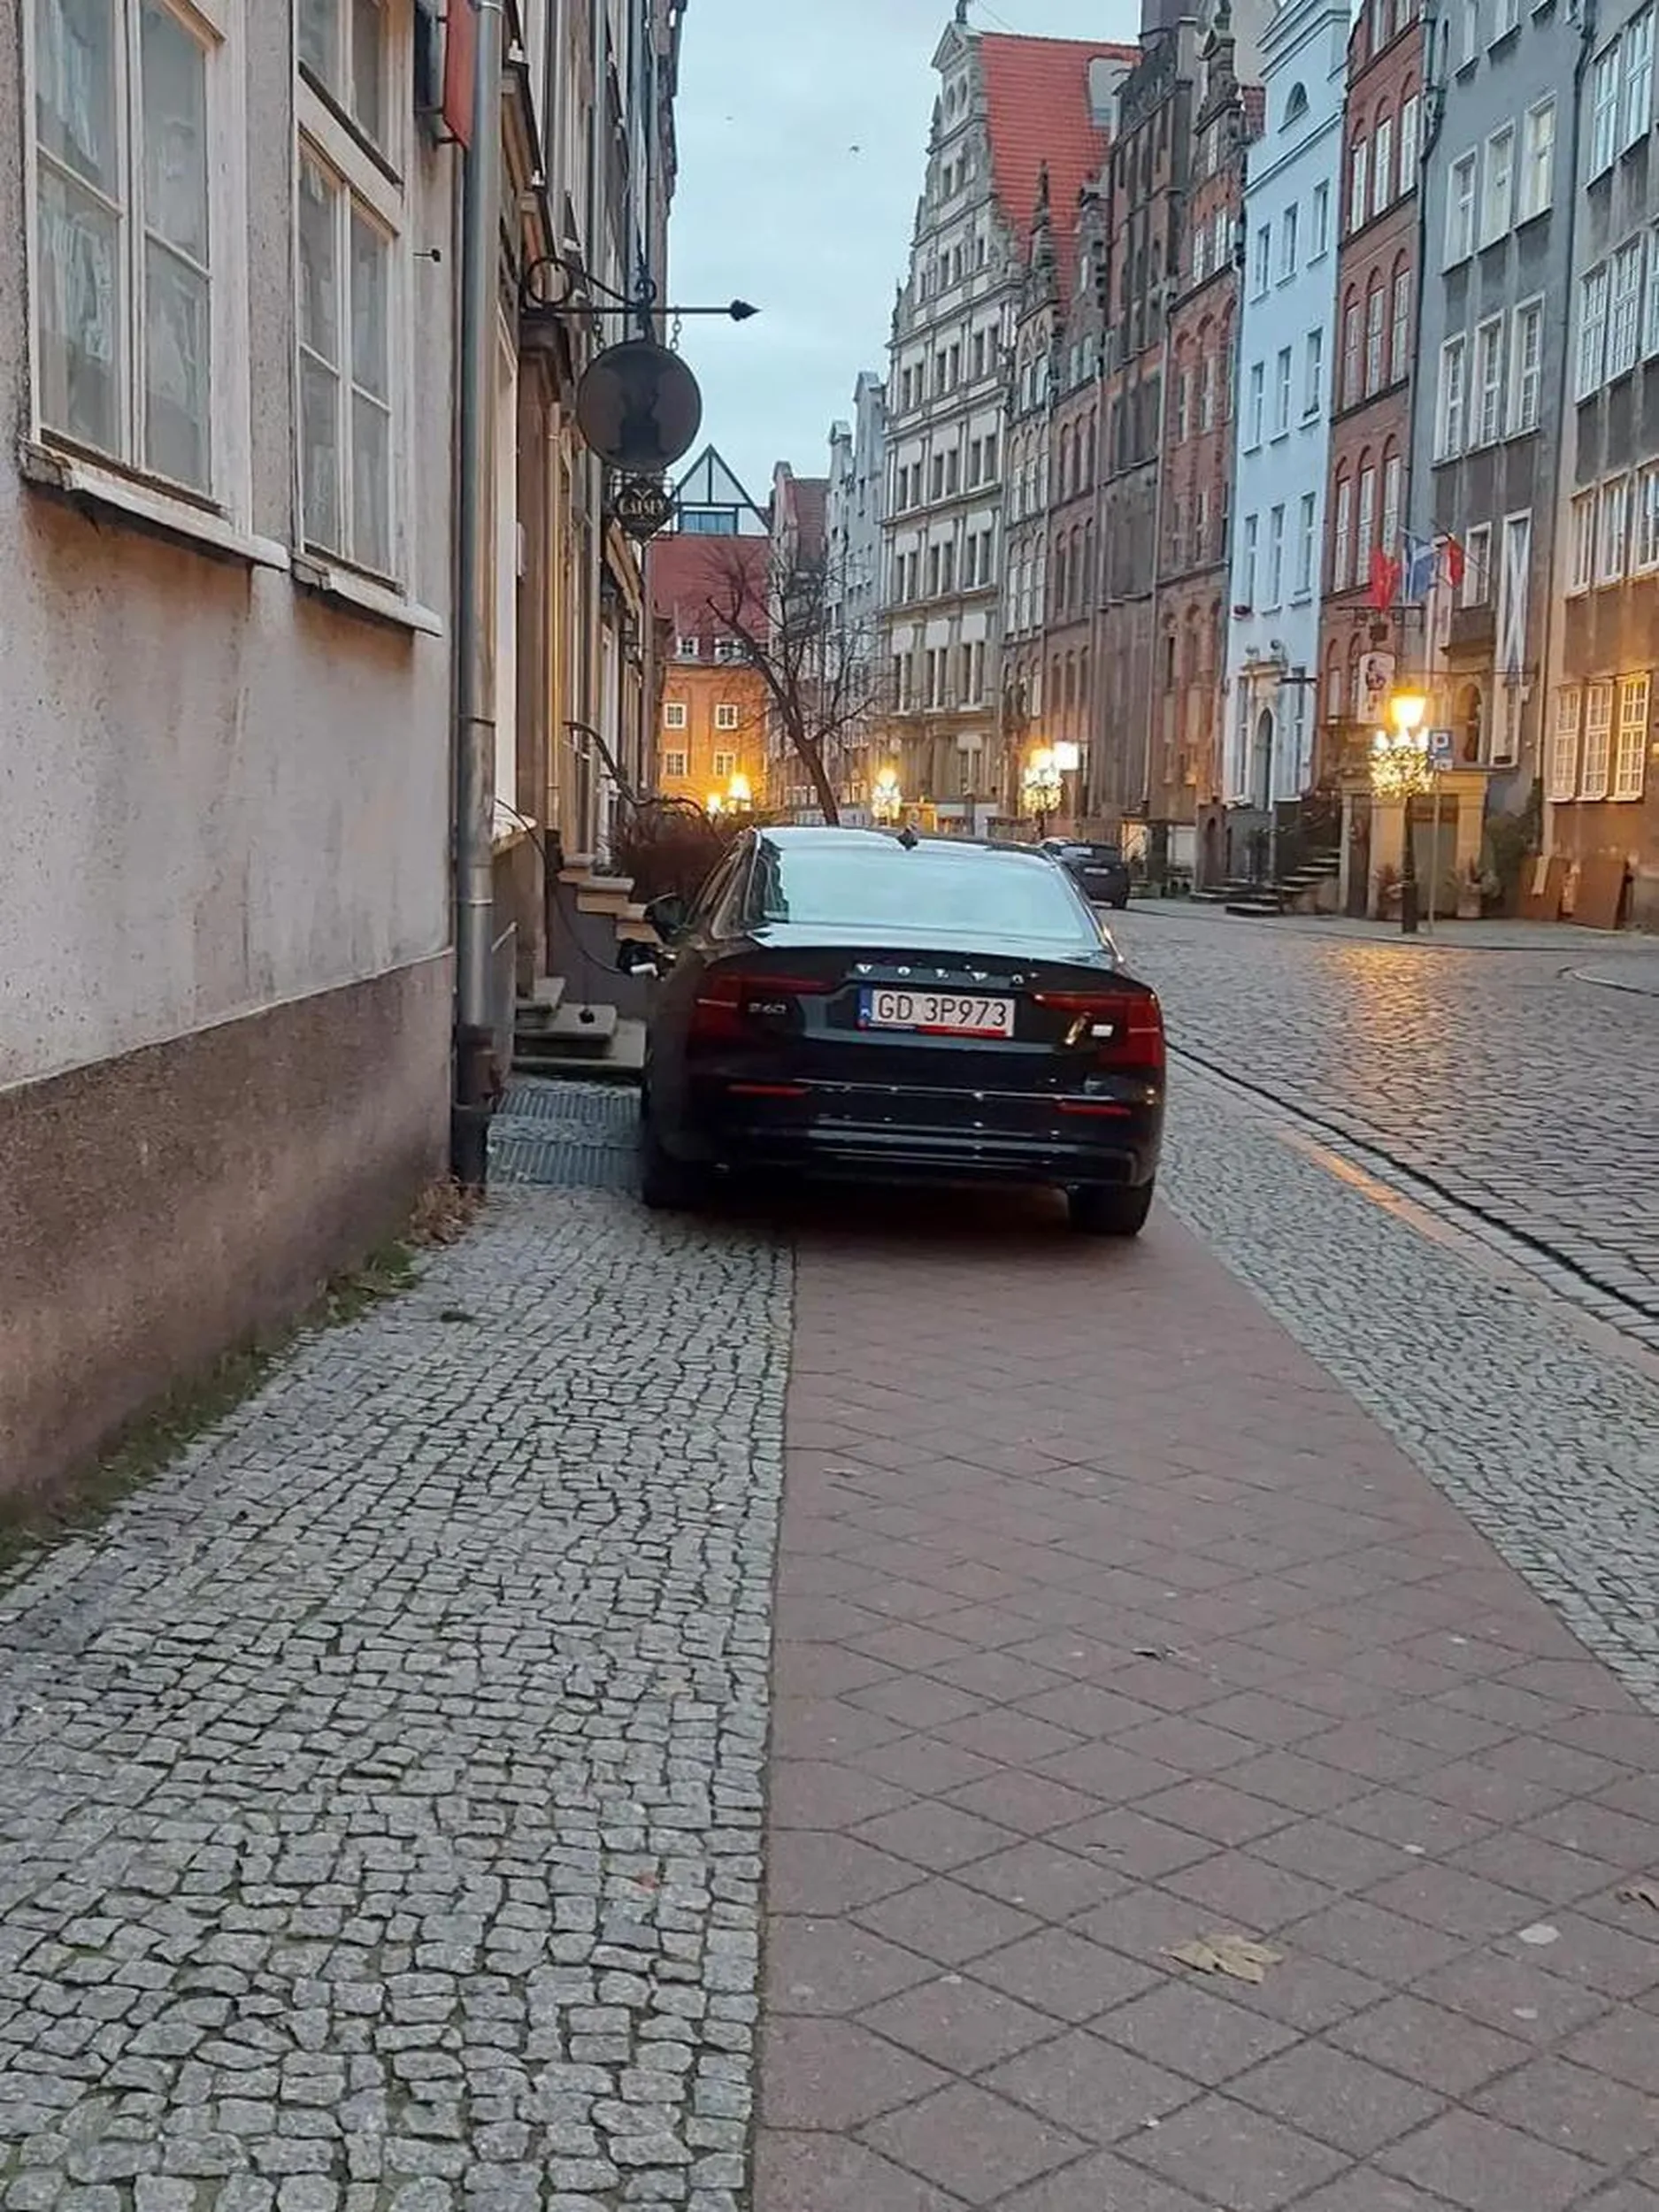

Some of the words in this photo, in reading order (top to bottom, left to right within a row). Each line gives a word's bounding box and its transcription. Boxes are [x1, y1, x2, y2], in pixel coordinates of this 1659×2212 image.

[856, 963, 1025, 985] VOLVO
[878, 994, 913, 1020] GD
[925, 997, 1007, 1027] 3P973
